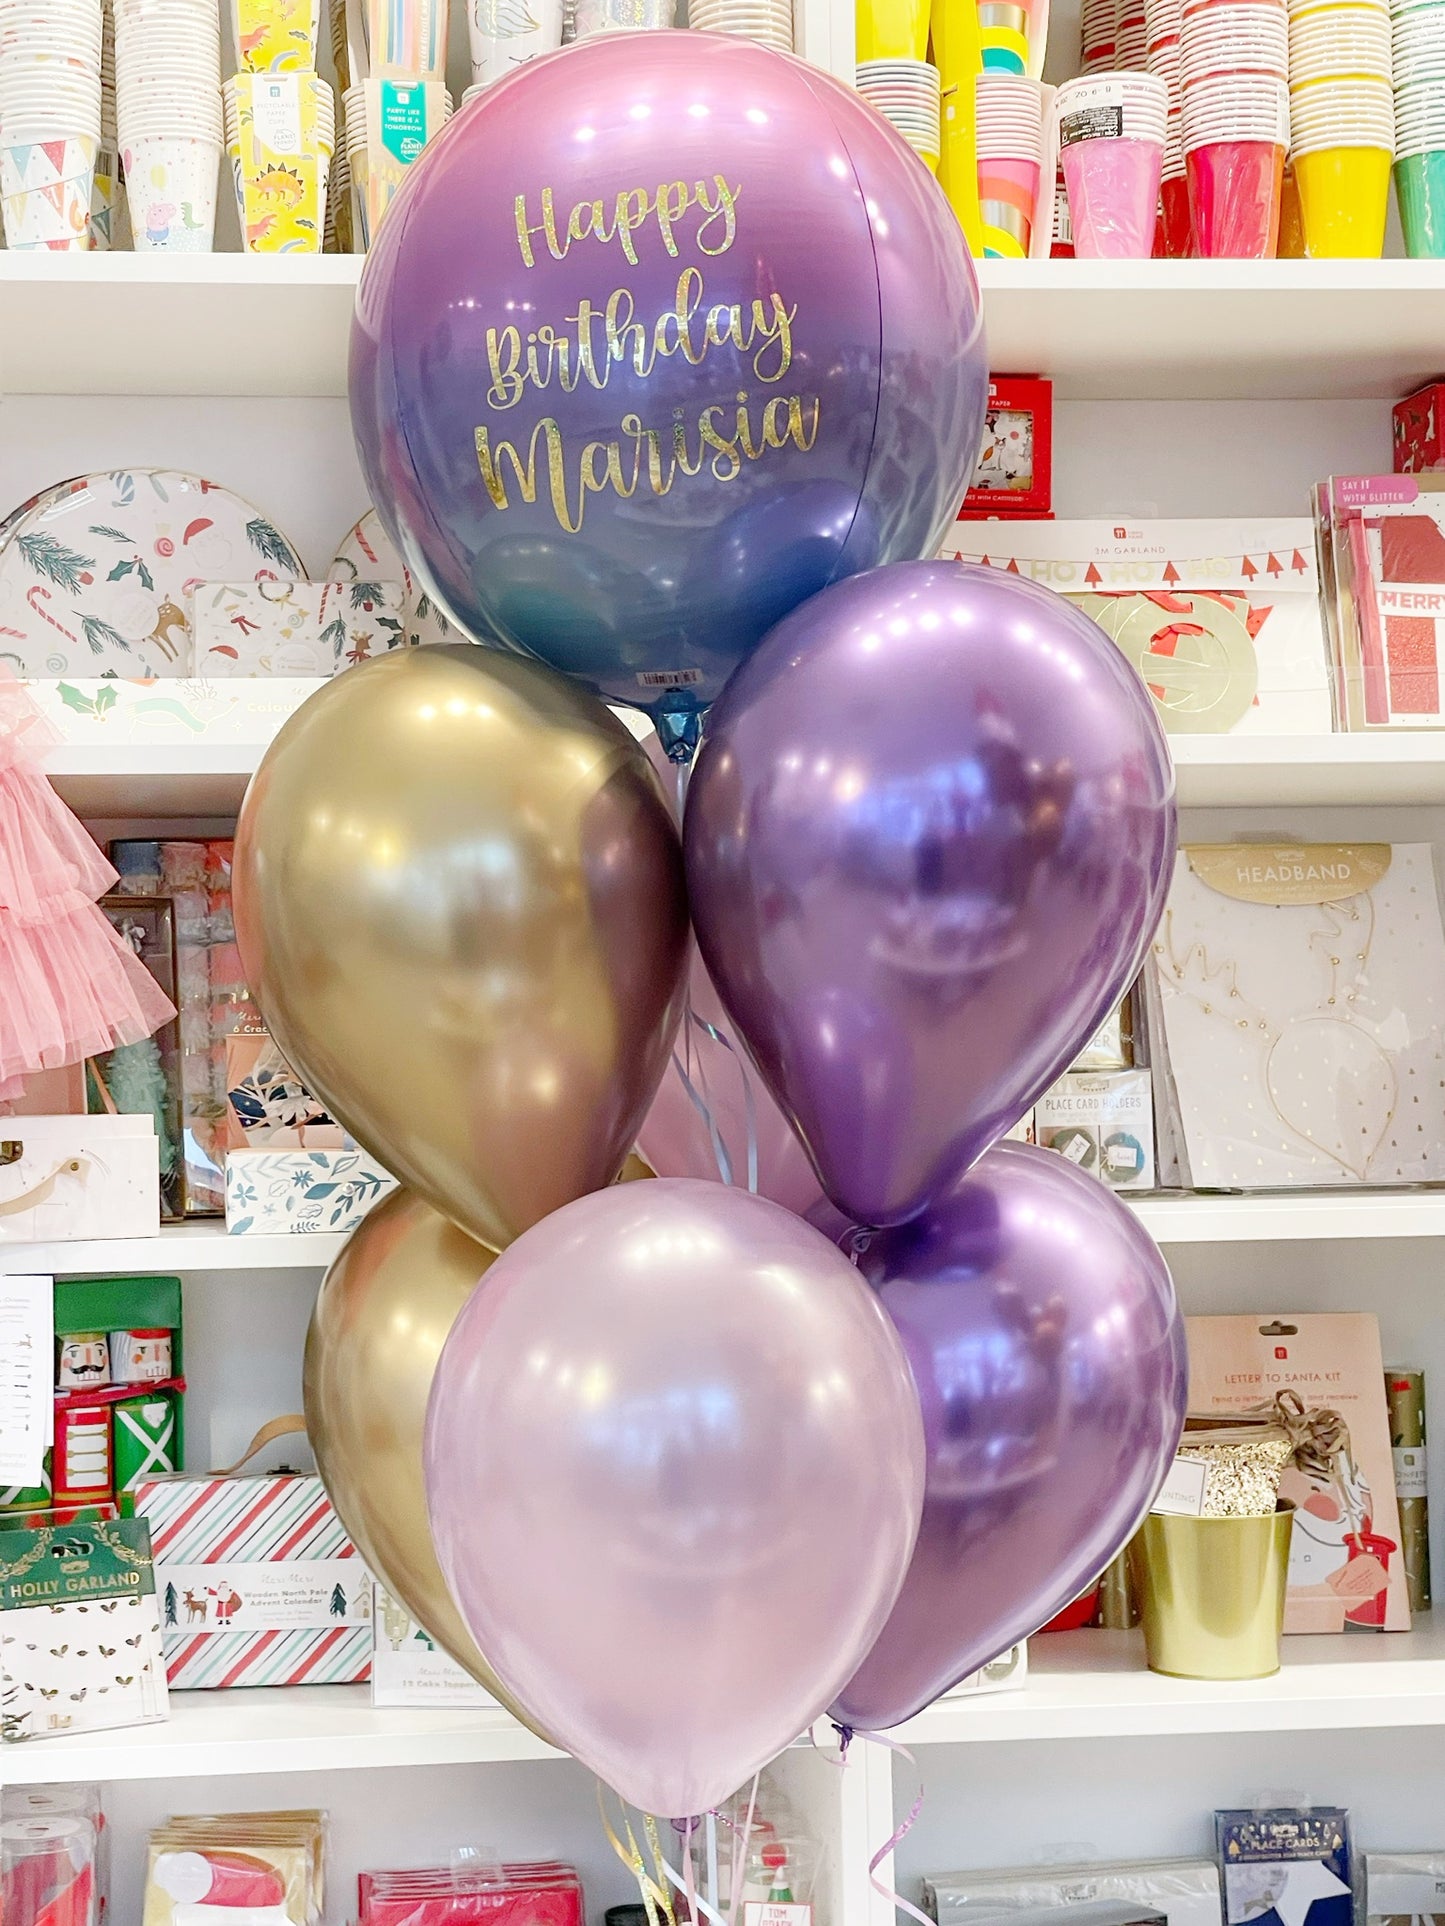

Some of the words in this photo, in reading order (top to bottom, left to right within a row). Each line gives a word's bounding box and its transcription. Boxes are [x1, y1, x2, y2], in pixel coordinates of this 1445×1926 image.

[386, 115, 406, 123] THERE
[384, 123, 423, 132] TOMORROW
[514, 175, 742, 269] Happy
[485, 266, 798, 411] Birthday
[474, 390, 820, 533] Marisia
[1342, 480, 1358, 490] SAY
[1361, 480, 1370, 490] IT
[1342, 493, 1366, 502] WITH
[1369, 491, 1404, 502] GLITTER
[1114, 546, 1166, 555] GARLAND
[1030, 559, 1077, 582] HO
[1109, 561, 1156, 583] HO
[1187, 556, 1232, 578] HO
[1236, 863, 1351, 883] HEADBAND
[233, 1025, 240, 1033] 6
[1045, 1099, 1072, 1111] PLACE
[1076, 1099, 1099, 1110] CARD
[1102, 1097, 1142, 1110] HOLDERS
[1225, 1373, 1262, 1384] LETTER
[1266, 1374, 1281, 1382] TO
[1284, 1373, 1321, 1382] SANTA
[1325, 1372, 1341, 1381] KIT
[10, 1581, 60, 1598] HOLLY
[65, 1571, 140, 1592] GARLAND
[282, 1589, 307, 1597] North
[310, 1588, 328, 1596] Pole
[250, 1599, 280, 1607] Advent
[283, 1598, 322, 1606] Calendar
[416, 1680, 441, 1688] Cake
[1250, 1840, 1283, 1850] PLACE
[1285, 1837, 1320, 1848] CARDS
[768, 1908, 788, 1920] TOM
